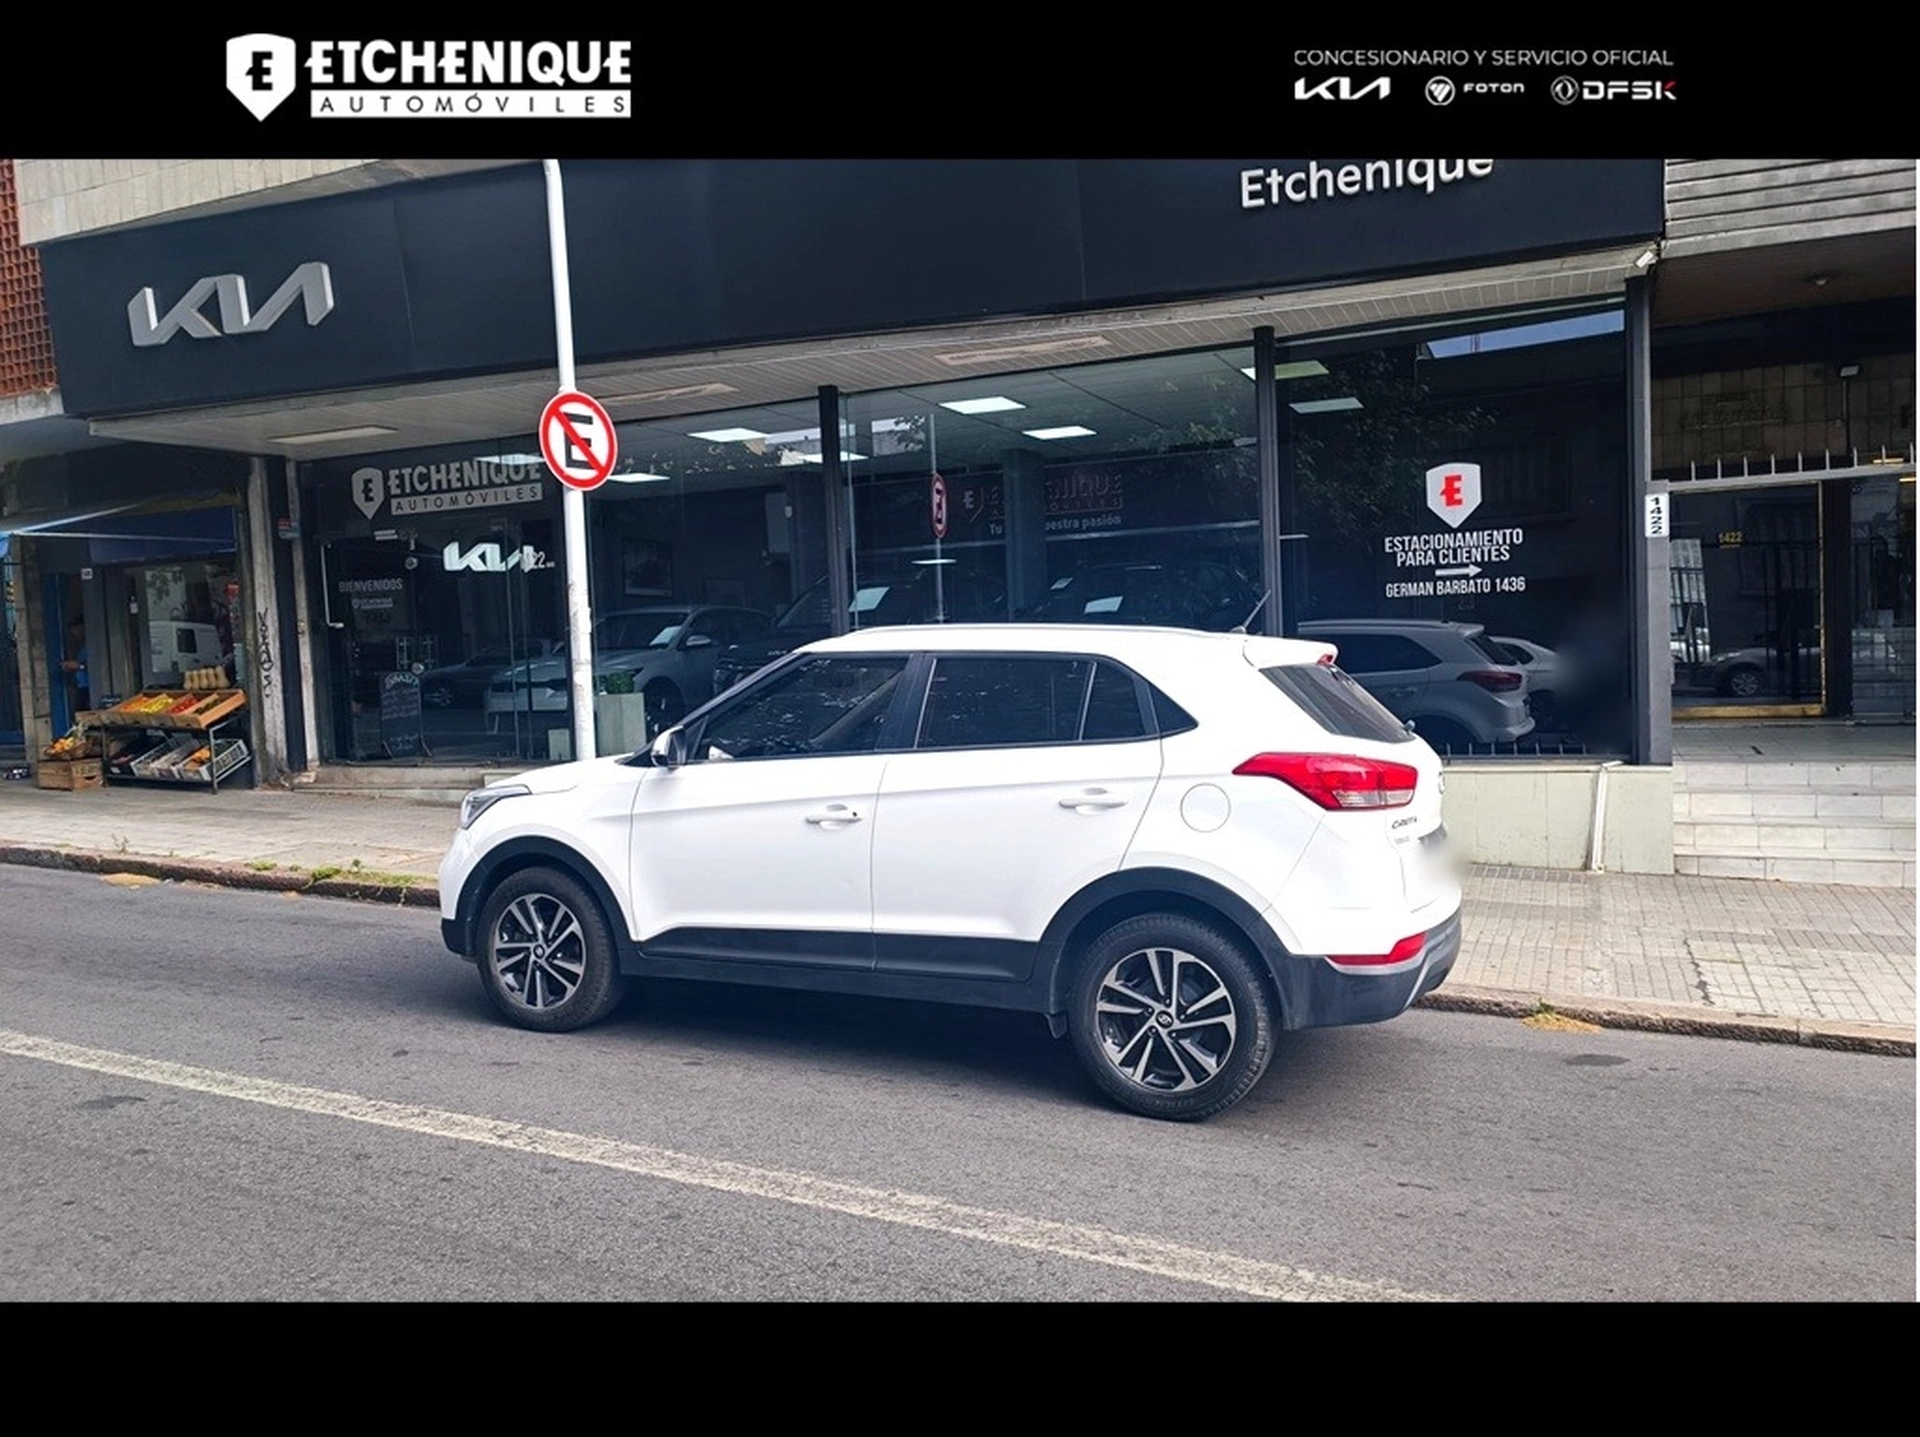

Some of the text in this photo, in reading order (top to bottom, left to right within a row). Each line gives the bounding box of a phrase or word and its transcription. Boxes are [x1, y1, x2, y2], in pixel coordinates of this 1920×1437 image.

[1241, 159, 1493, 208] Etchenique
[128, 262, 334, 346] KIA
[388, 458, 541, 495] ETCHENIQUE
[395, 485, 538, 512] AUTOMÓVILES
[1650, 497, 1662, 534] 1422
[1384, 528, 1523, 552] ESTACIONAMIENTO
[1397, 545, 1510, 567] PARA CLIENTES
[1386, 576, 1526, 598] GERMAN BARBATO 1436
